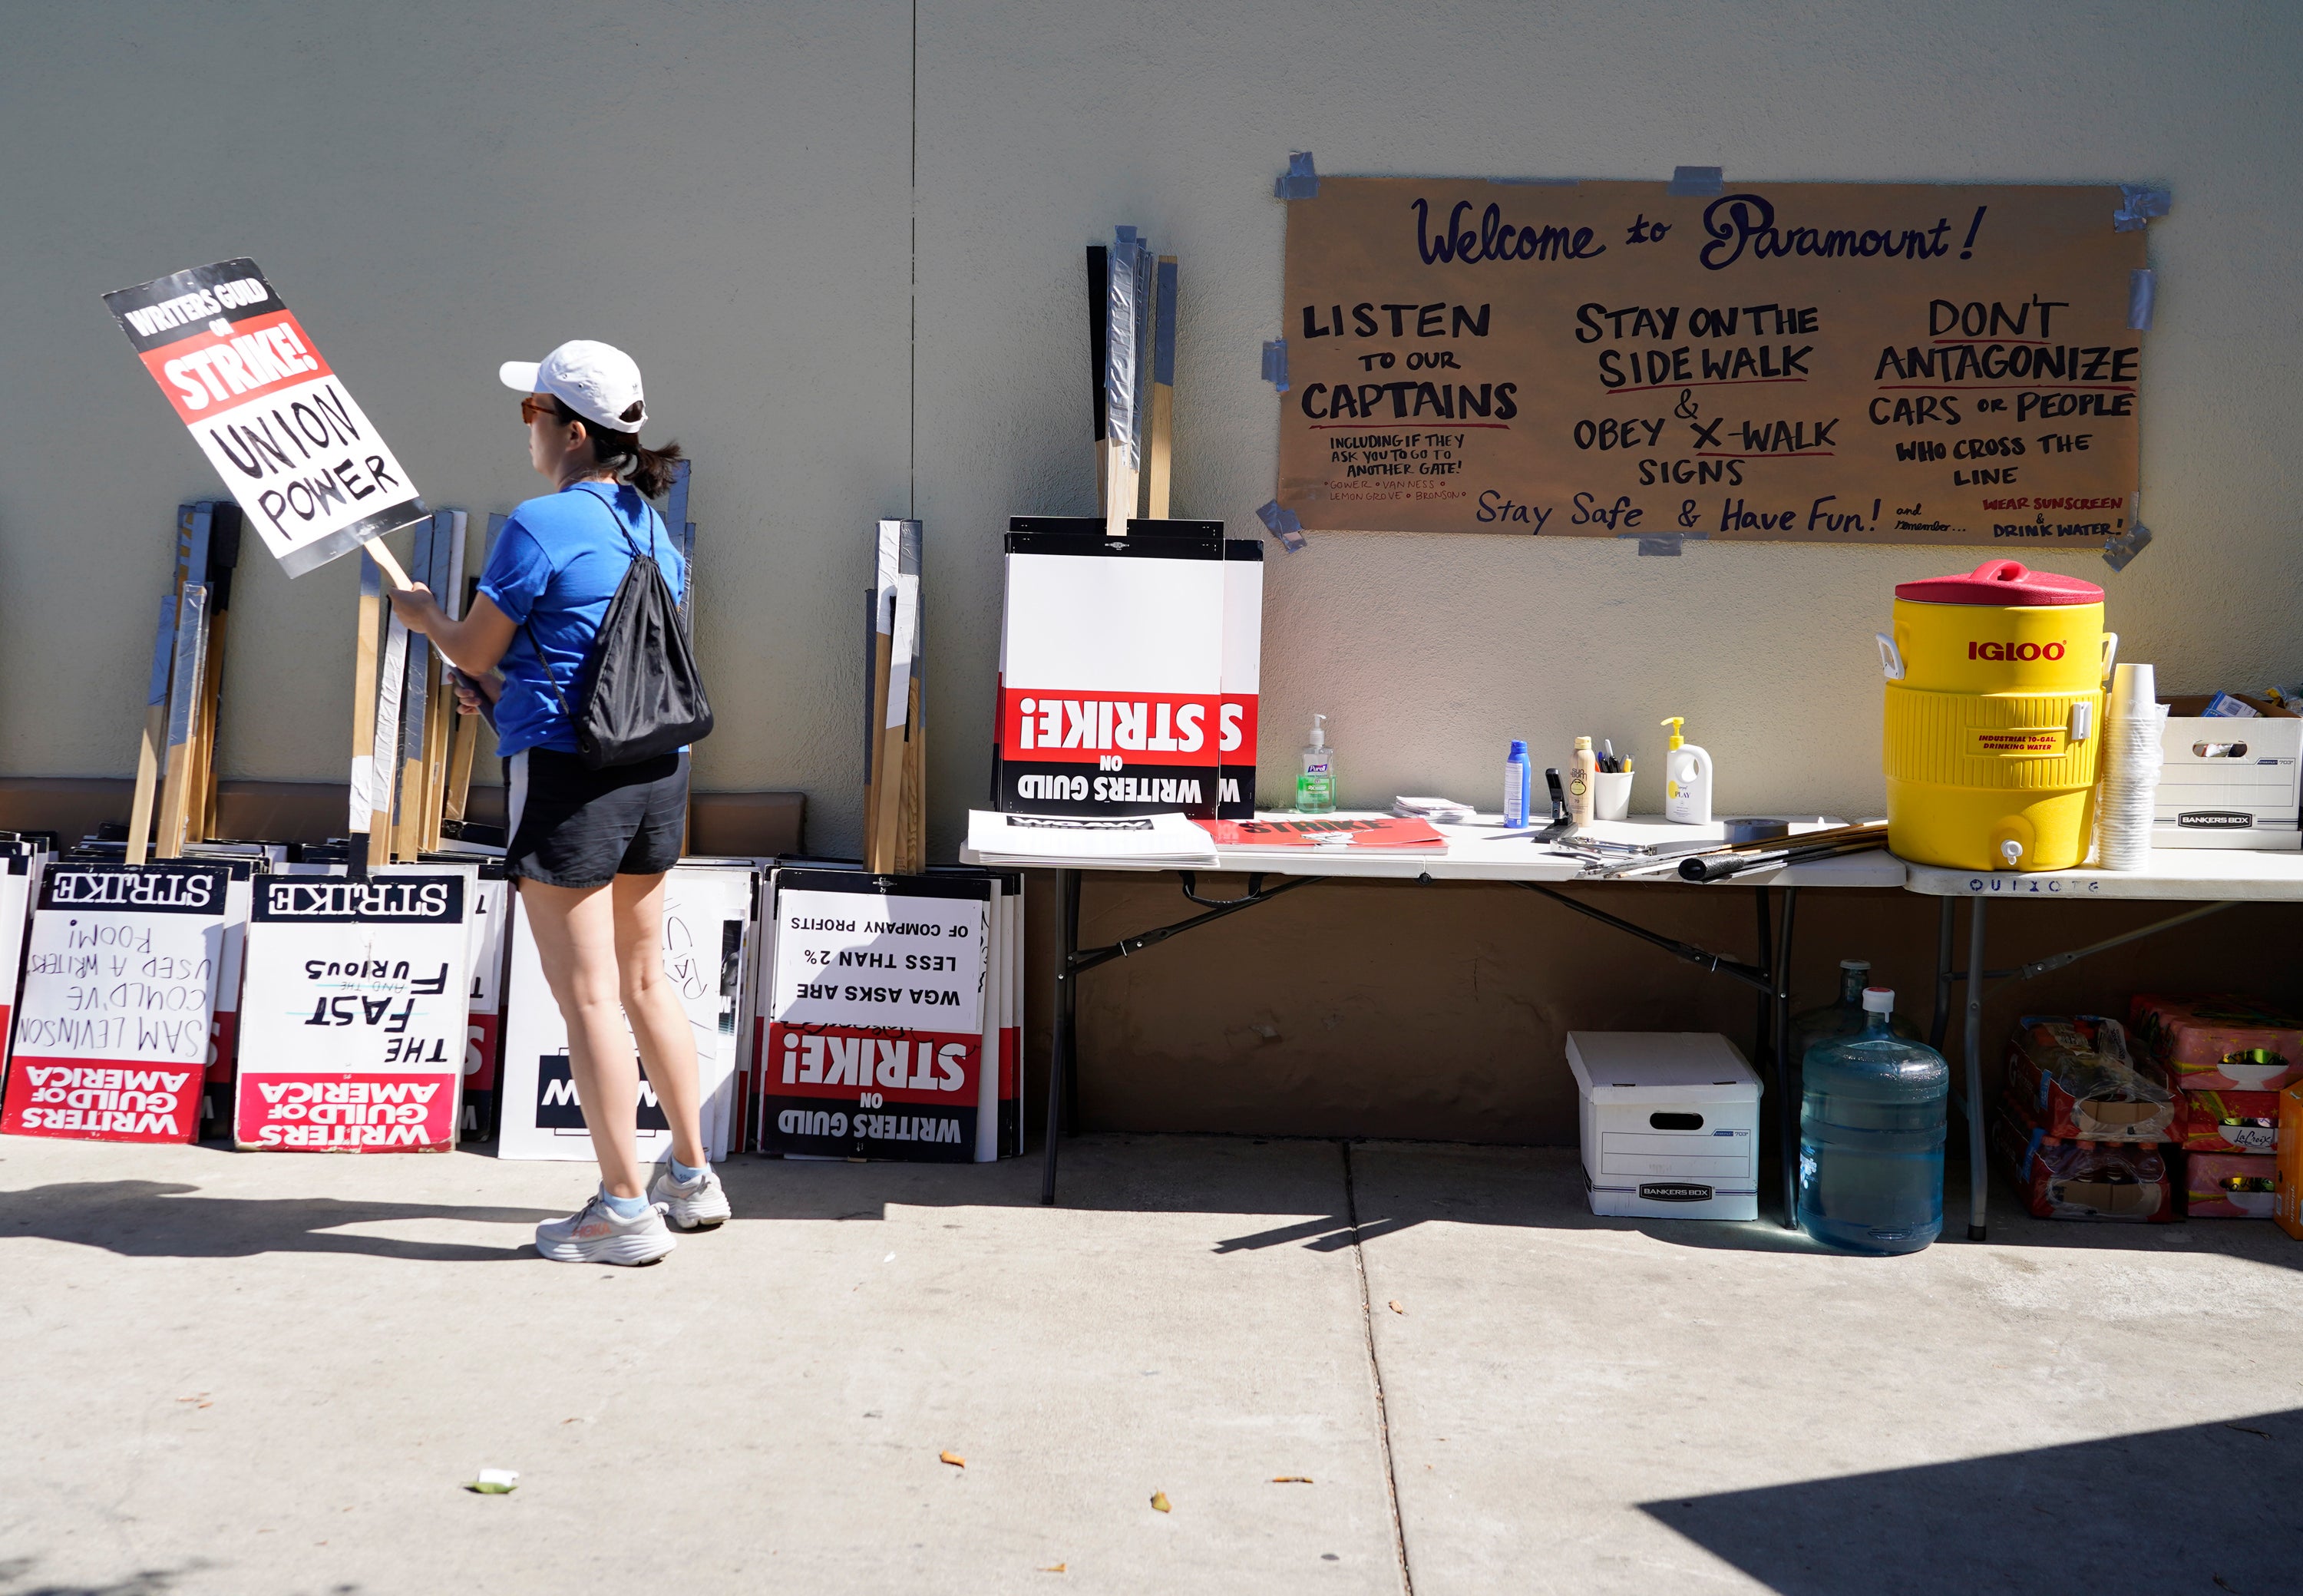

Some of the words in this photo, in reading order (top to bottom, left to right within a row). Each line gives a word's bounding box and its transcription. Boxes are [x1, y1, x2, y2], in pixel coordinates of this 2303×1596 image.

[1411, 197, 1607, 265] Welcome
[1626, 213, 1672, 245] to
[1699, 193, 1987, 271] Paramount!
[124, 288, 222, 338] WRITERS
[216, 277, 269, 309] GUILD
[1929, 293, 2070, 339] DON'T
[208, 316, 235, 338] ON
[1303, 301, 1490, 339] LISTEN
[1574, 302, 1680, 343] STAY
[1689, 306, 1739, 339] ON
[1742, 303, 1819, 336] THE
[164, 322, 319, 411] STRIKE!
[1358, 352, 1396, 372] TO
[1406, 351, 1462, 371] OUR
[1874, 345, 2139, 382] ANTAGONIZE
[1301, 381, 1518, 420] CAPTAINS
[1674, 388, 1699, 420] &
[1868, 395, 1962, 426] CARS
[1977, 398, 2008, 413] OR
[2017, 392, 2137, 422] PEOPLE
[210, 384, 360, 480] UNION
[1330, 435, 1403, 449] INCLUDING
[1406, 434, 1422, 448] IF
[1425, 434, 1465, 448] THEY
[1574, 418, 1667, 451] OBEY
[1689, 417, 1840, 453] X-WALK
[1331, 451, 1358, 462] ASK
[1363, 451, 1388, 464] YOU
[1390, 448, 1408, 461] TO
[1410, 449, 1428, 460] GO
[1432, 450, 1452, 461] TO
[1895, 441, 1947, 462] WHO
[1953, 436, 2027, 461] CROSS
[2037, 434, 2093, 455] THE
[1346, 464, 1414, 477] ANOTHER
[1419, 461, 1462, 475] GATE!
[1638, 459, 1746, 486] SIGNS
[1953, 467, 2019, 487] LINE
[1330, 480, 1372, 490] GOWER
[1383, 481, 1405, 490] VAN
[1408, 480, 1435, 489] NESS
[1330, 492, 1363, 501] LEMON
[1366, 491, 1403, 501] GROVE
[1416, 490, 1460, 501] BRONSON
[257, 454, 399, 541] POWER
[1896, 503, 1921, 516] and
[1982, 497, 2030, 511] WEAR
[2034, 497, 2123, 511] SUNSCREEN
[1476, 490, 1553, 535] Stay
[1571, 491, 1643, 530] Safe
[1677, 499, 1701, 527] &
[1720, 497, 1796, 532] Have
[1807, 495, 1881, 532] Fun!
[2036, 513, 2045, 524] &
[1993, 524, 2053, 537] DRINK
[2057, 518, 2124, 537] WATER!
[1968, 640, 2065, 662] IGLOO
[1019, 696, 1206, 753] STRIKE!
[1099, 755, 1123, 772] ON
[1017, 774, 1089, 801] GUILD
[1094, 778, 1203, 804] WRITERS
[1238, 819, 1393, 834] STRIKE
[51, 871, 213, 907] STRIKE
[267, 882, 448, 917] STRIKE
[69, 919, 150, 953] ROOM!
[791, 917, 856, 932] PROFITS
[864, 921, 941, 937] COMPANY
[948, 925, 969, 938] OF
[108, 954, 127, 977] A
[142, 957, 212, 980] USED
[804, 948, 831, 965] 2%
[839, 950, 897, 969] THAN
[906, 954, 957, 972] LESS
[304, 959, 449, 995] FURIOUS
[796, 983, 838, 999] ARE
[844, 985, 902, 1003] ASKS
[910, 988, 960, 1006] WGA
[304, 995, 415, 1033] FAST
[17, 1016, 125, 1050] LEVINSON
[137, 1016, 203, 1058] SAM
[384, 1037, 448, 1063] THE
[782, 1033, 967, 1092] STRIKE!
[25, 1065, 190, 1092] AMERICA
[31, 1086, 61, 1103] OF
[67, 1089, 178, 1114] GUILD
[257, 1082, 441, 1104] AMERICA
[860, 1092, 884, 1109] ON
[21, 1107, 180, 1136] WRITERS
[267, 1103, 306, 1119] OF
[308, 1103, 429, 1125] GUILD
[778, 1109, 848, 1135] GUILD
[258, 1124, 432, 1147] WRITERS
[854, 1113, 962, 1144] WRITERS
[571, 1221, 613, 1239] HOKA
